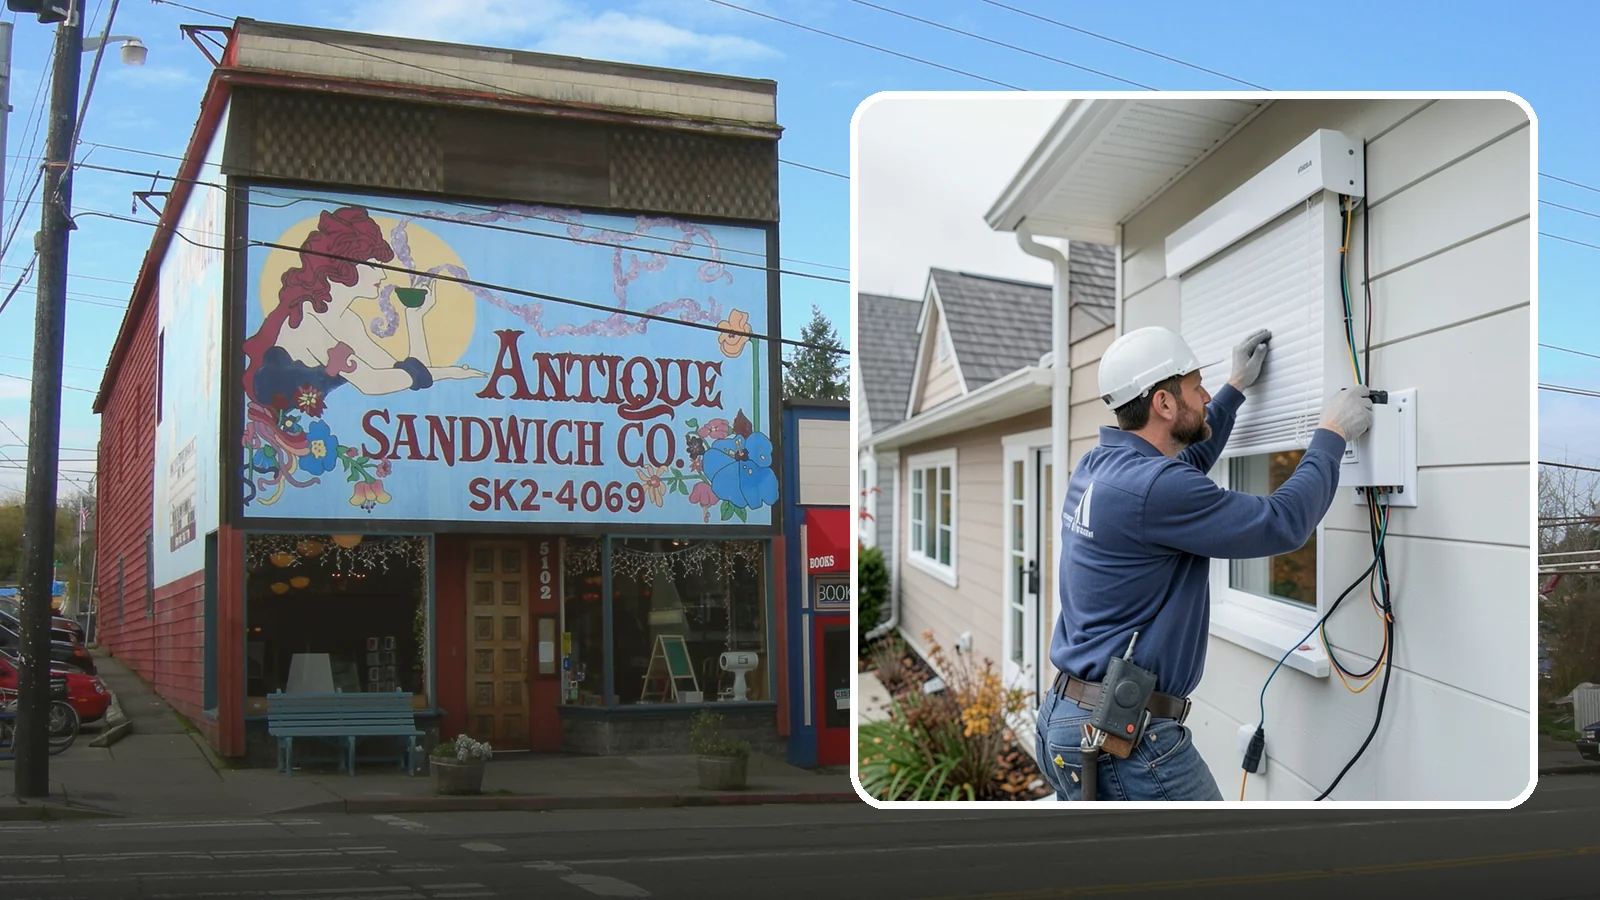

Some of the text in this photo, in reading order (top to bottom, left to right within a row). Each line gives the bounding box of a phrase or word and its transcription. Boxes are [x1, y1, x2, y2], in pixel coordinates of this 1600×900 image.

[475, 328, 724, 421] ANTIQUE
[361, 408, 685, 469] SANDWICH CO.
[468, 477, 645, 513] SK2-4069
[540, 541, 551, 600] 5102
[809, 555, 835, 569] BOOKS
